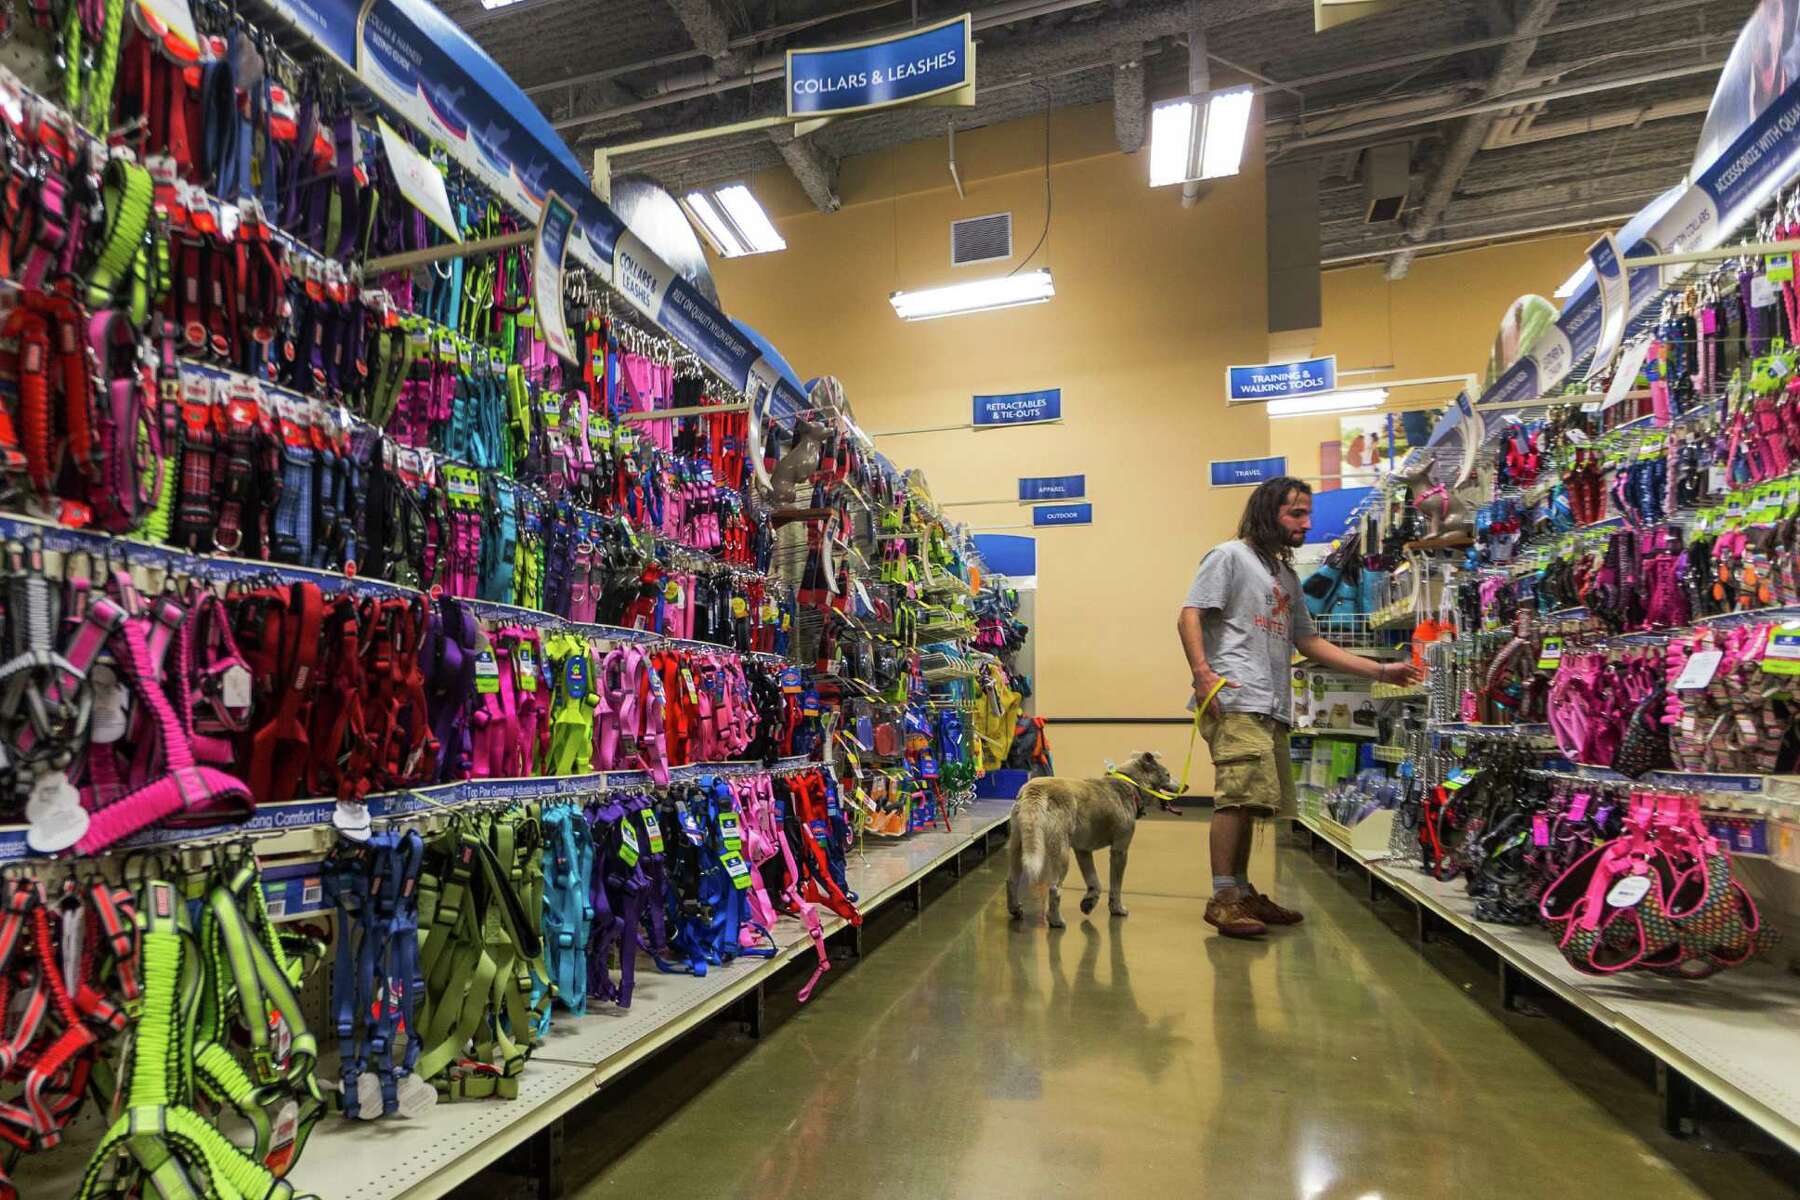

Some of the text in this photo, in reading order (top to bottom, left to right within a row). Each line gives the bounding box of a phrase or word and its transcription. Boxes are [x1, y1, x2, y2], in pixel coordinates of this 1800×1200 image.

[793, 50, 957, 95] COLLARS & LEASHES
[1714, 142, 1762, 195] ACCESSORIZE
[1757, 126, 1783, 154] WITH
[619, 252, 652, 291] COLLARS
[622, 272, 651, 308] LEASHES
[1251, 369, 1311, 384] TRAINING &
[1240, 377, 1325, 394] WALKING TOOLS
[985, 398, 1048, 412] RETRACTABLES
[992, 408, 1041, 420] & TIE-OUTS
[1235, 468, 1263, 477] TRAVEL
[1037, 485, 1066, 494] APPAREL
[1045, 511, 1079, 520] OUTDOOR
[274, 810, 315, 827] Comfort
